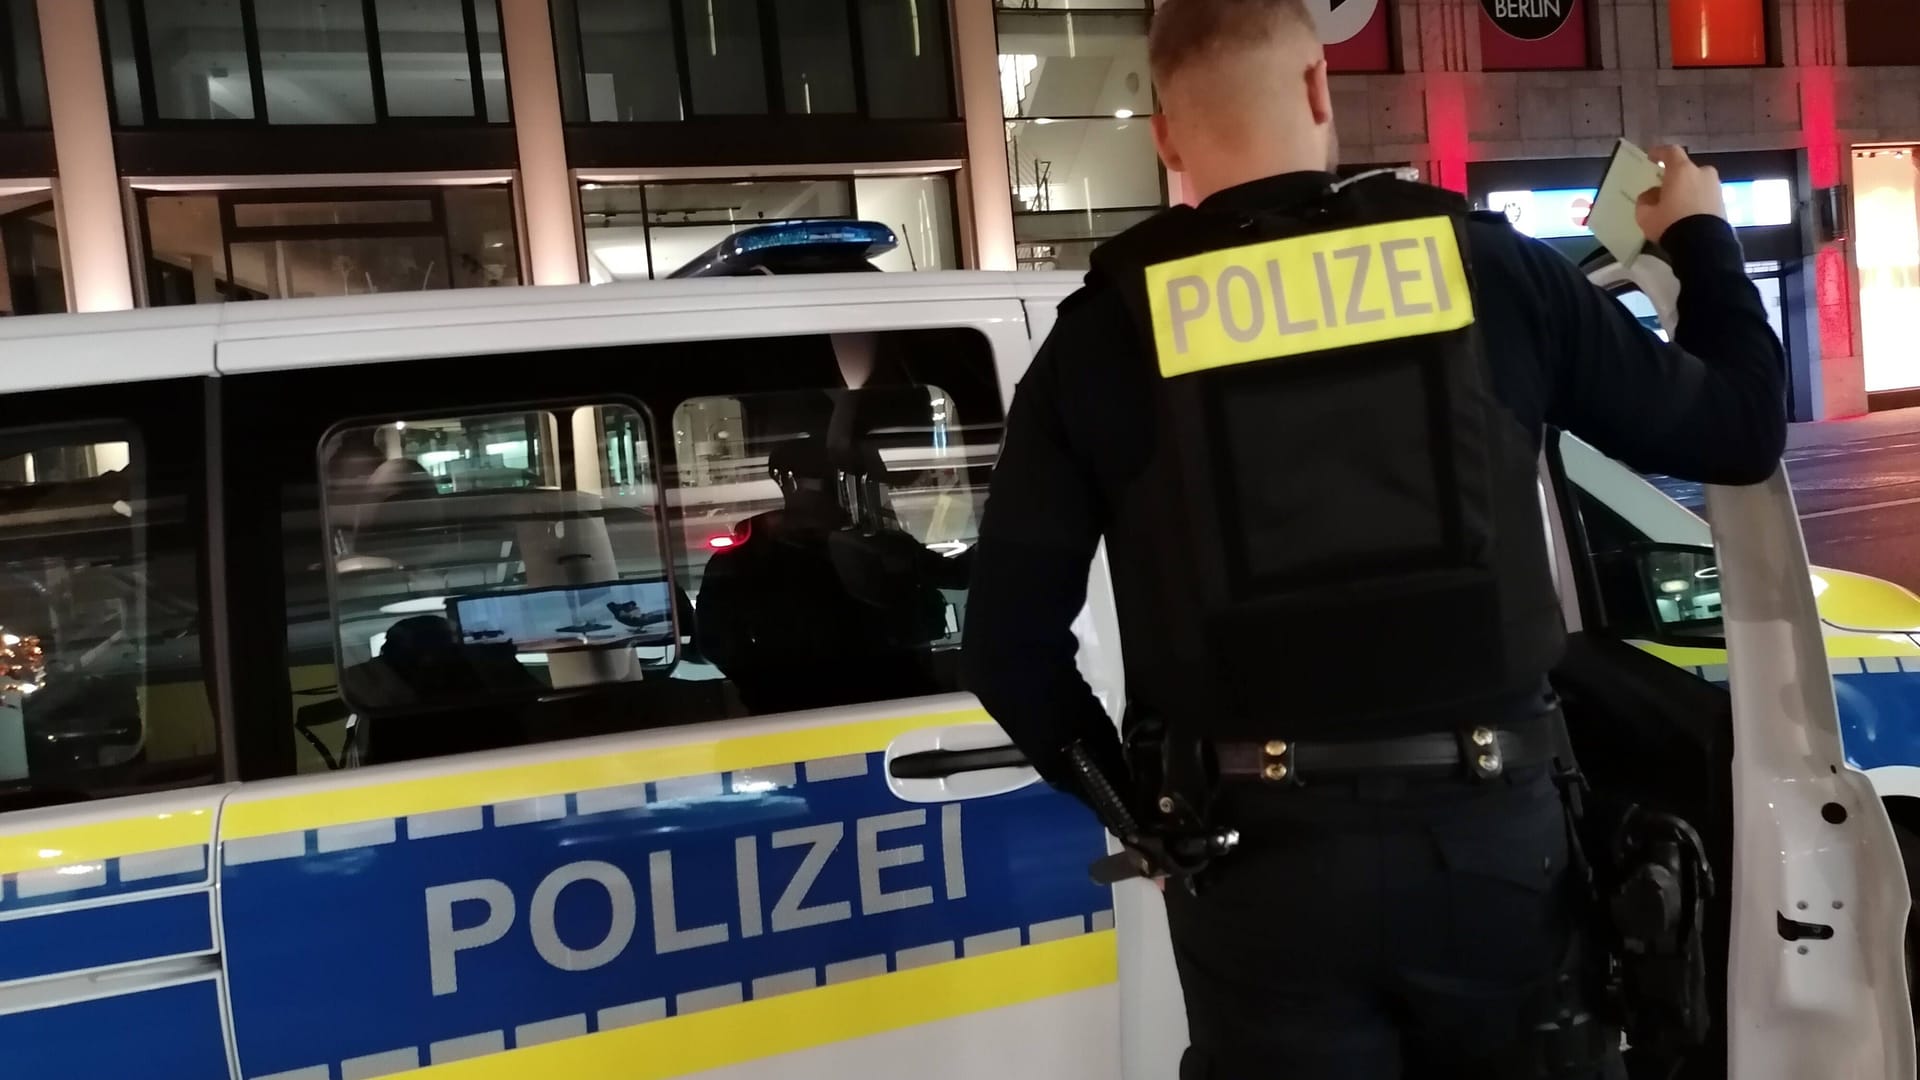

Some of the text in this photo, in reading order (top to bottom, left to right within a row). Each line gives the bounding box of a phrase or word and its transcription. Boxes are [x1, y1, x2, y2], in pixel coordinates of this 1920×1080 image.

[1494, 0, 1561, 18] BERLIN
[1166, 236, 1452, 355] POLIZEI
[425, 802, 967, 996] POLIZEI
